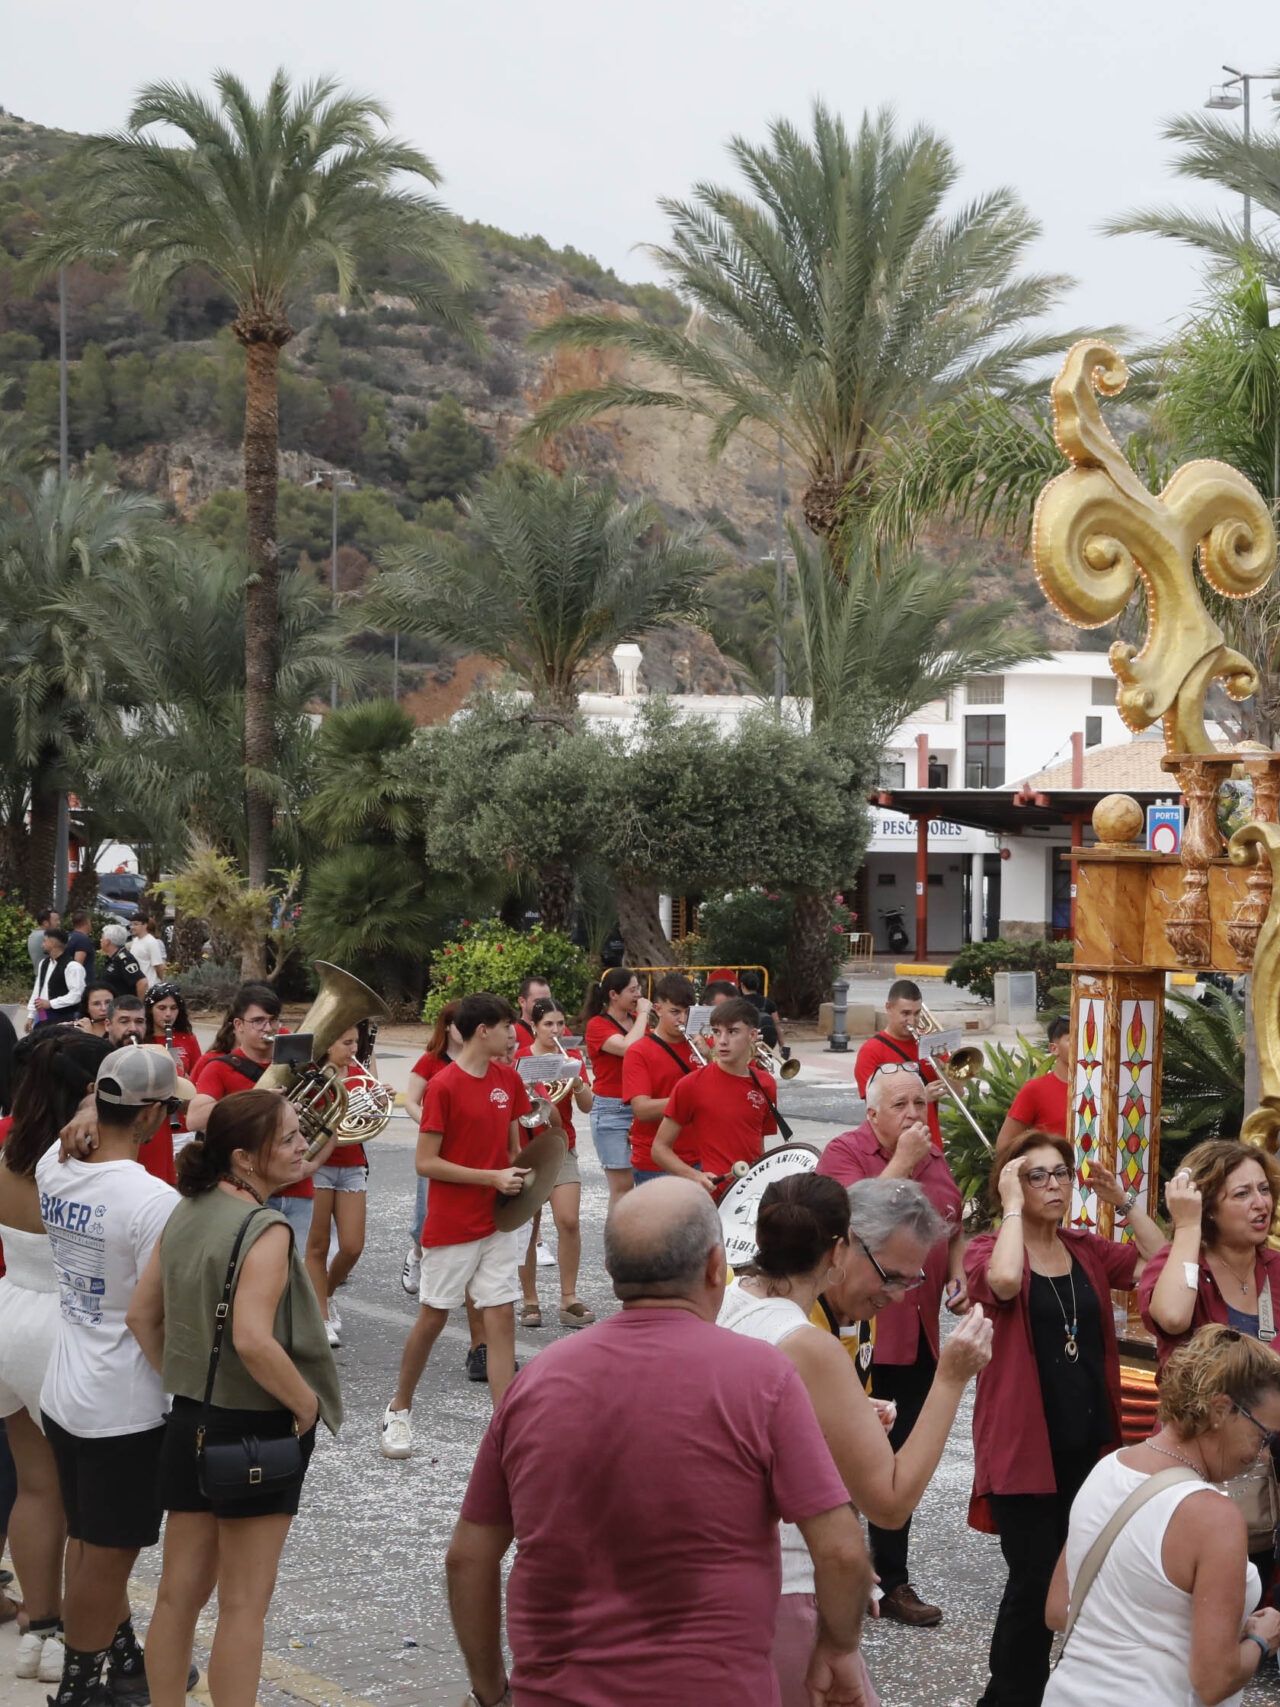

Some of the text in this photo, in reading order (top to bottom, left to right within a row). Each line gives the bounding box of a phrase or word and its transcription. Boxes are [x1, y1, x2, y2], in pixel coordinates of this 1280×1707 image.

[883, 821, 962, 835] PESCORES
[1155, 812, 1179, 820] PORTS
[736, 1161, 771, 1195] CENTRE
[41, 1192, 91, 1233] BIKER
